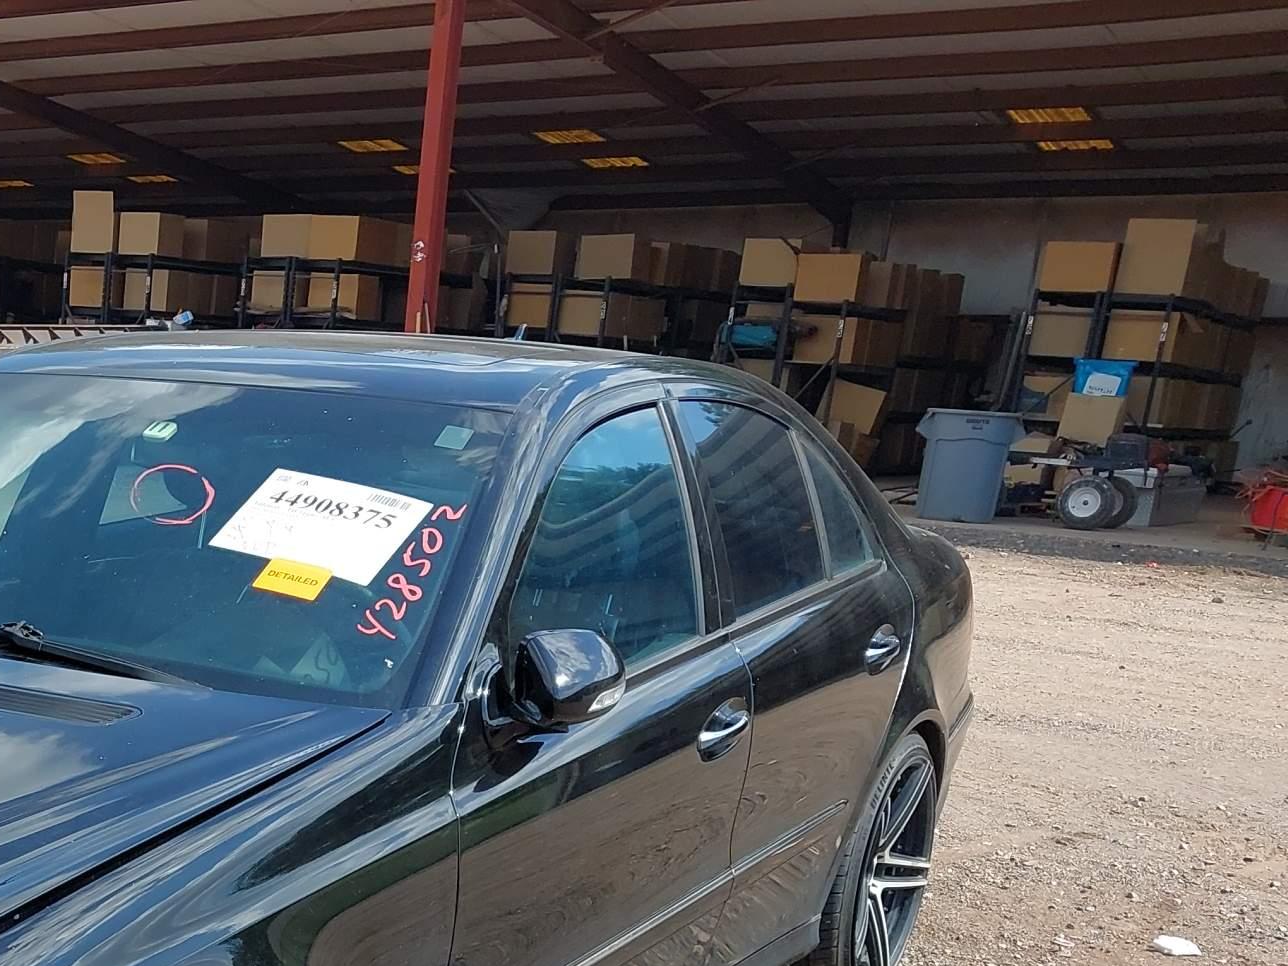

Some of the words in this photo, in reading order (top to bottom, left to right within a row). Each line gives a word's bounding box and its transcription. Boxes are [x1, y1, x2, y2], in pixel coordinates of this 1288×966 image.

[270, 490, 398, 528] 44908375
[267, 569, 319, 587] DETAILED
[357, 503, 467, 639] 428502
